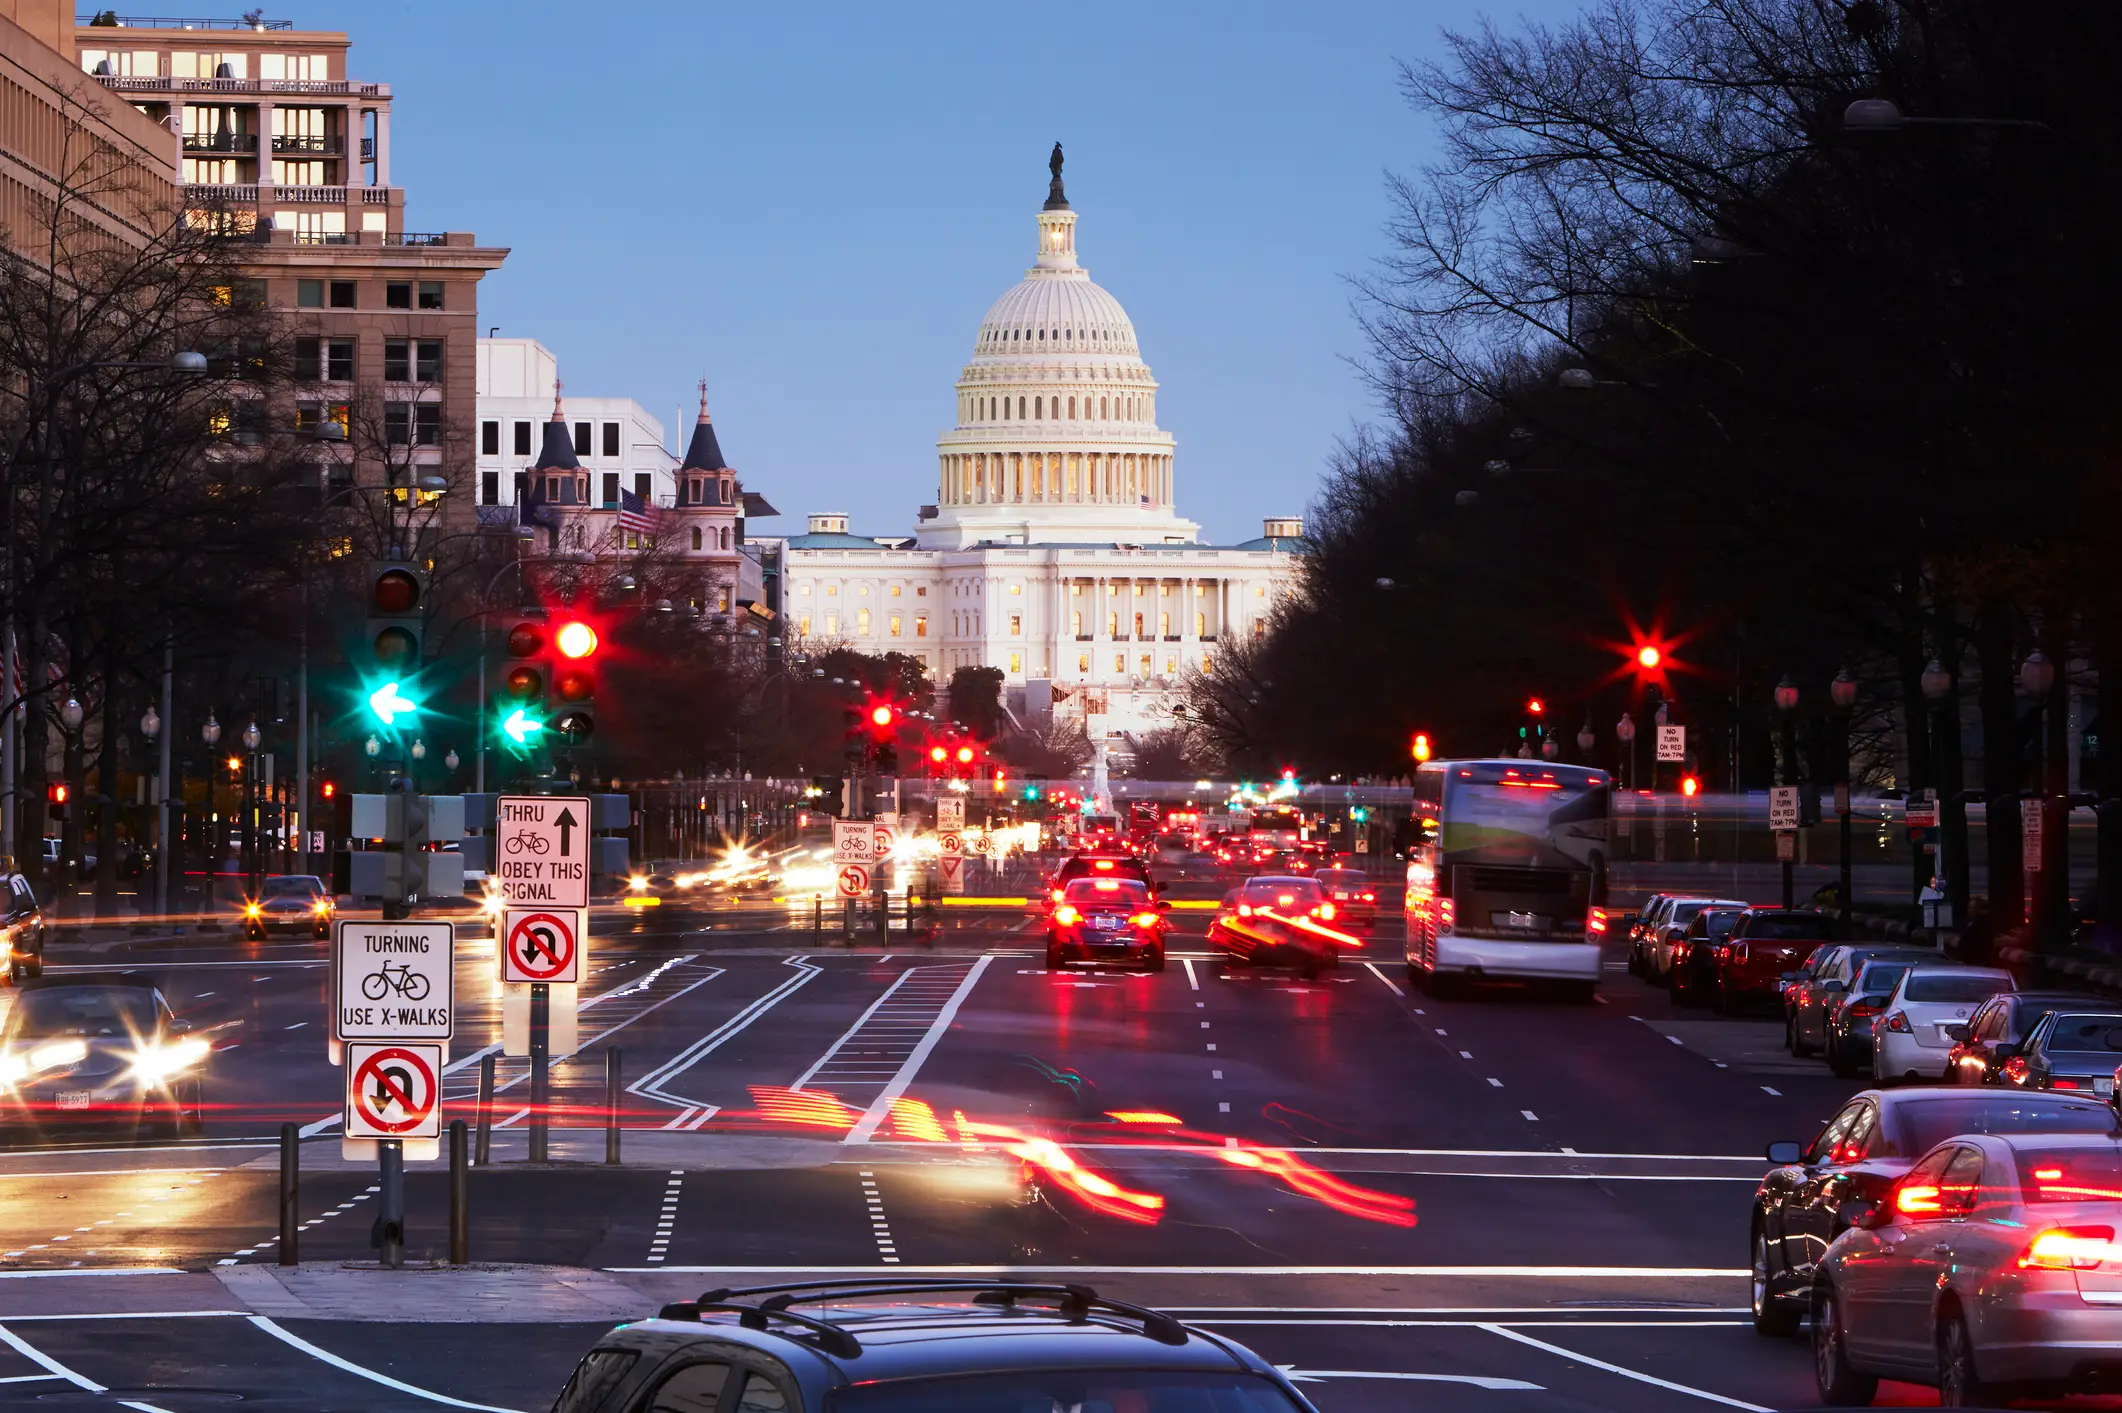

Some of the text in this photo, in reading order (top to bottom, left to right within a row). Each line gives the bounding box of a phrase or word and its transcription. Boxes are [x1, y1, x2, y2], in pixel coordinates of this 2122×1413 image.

[1657, 751, 1685, 759] 7AM-7PM
[1778, 790, 1789, 798] NO
[504, 805, 544, 822] THRU
[1772, 809, 1795, 817] ON RED
[953, 815, 964, 823] THIS
[1770, 818, 1797, 827] 7AM-7PM
[843, 826, 867, 834] TURNING
[848, 852, 873, 860] X-WALKS
[502, 862, 583, 880] OBEY THIS
[502, 883, 557, 900] SIGNAL
[364, 935, 430, 954] TURNING
[344, 1008, 448, 1026] USE X-WALKS
